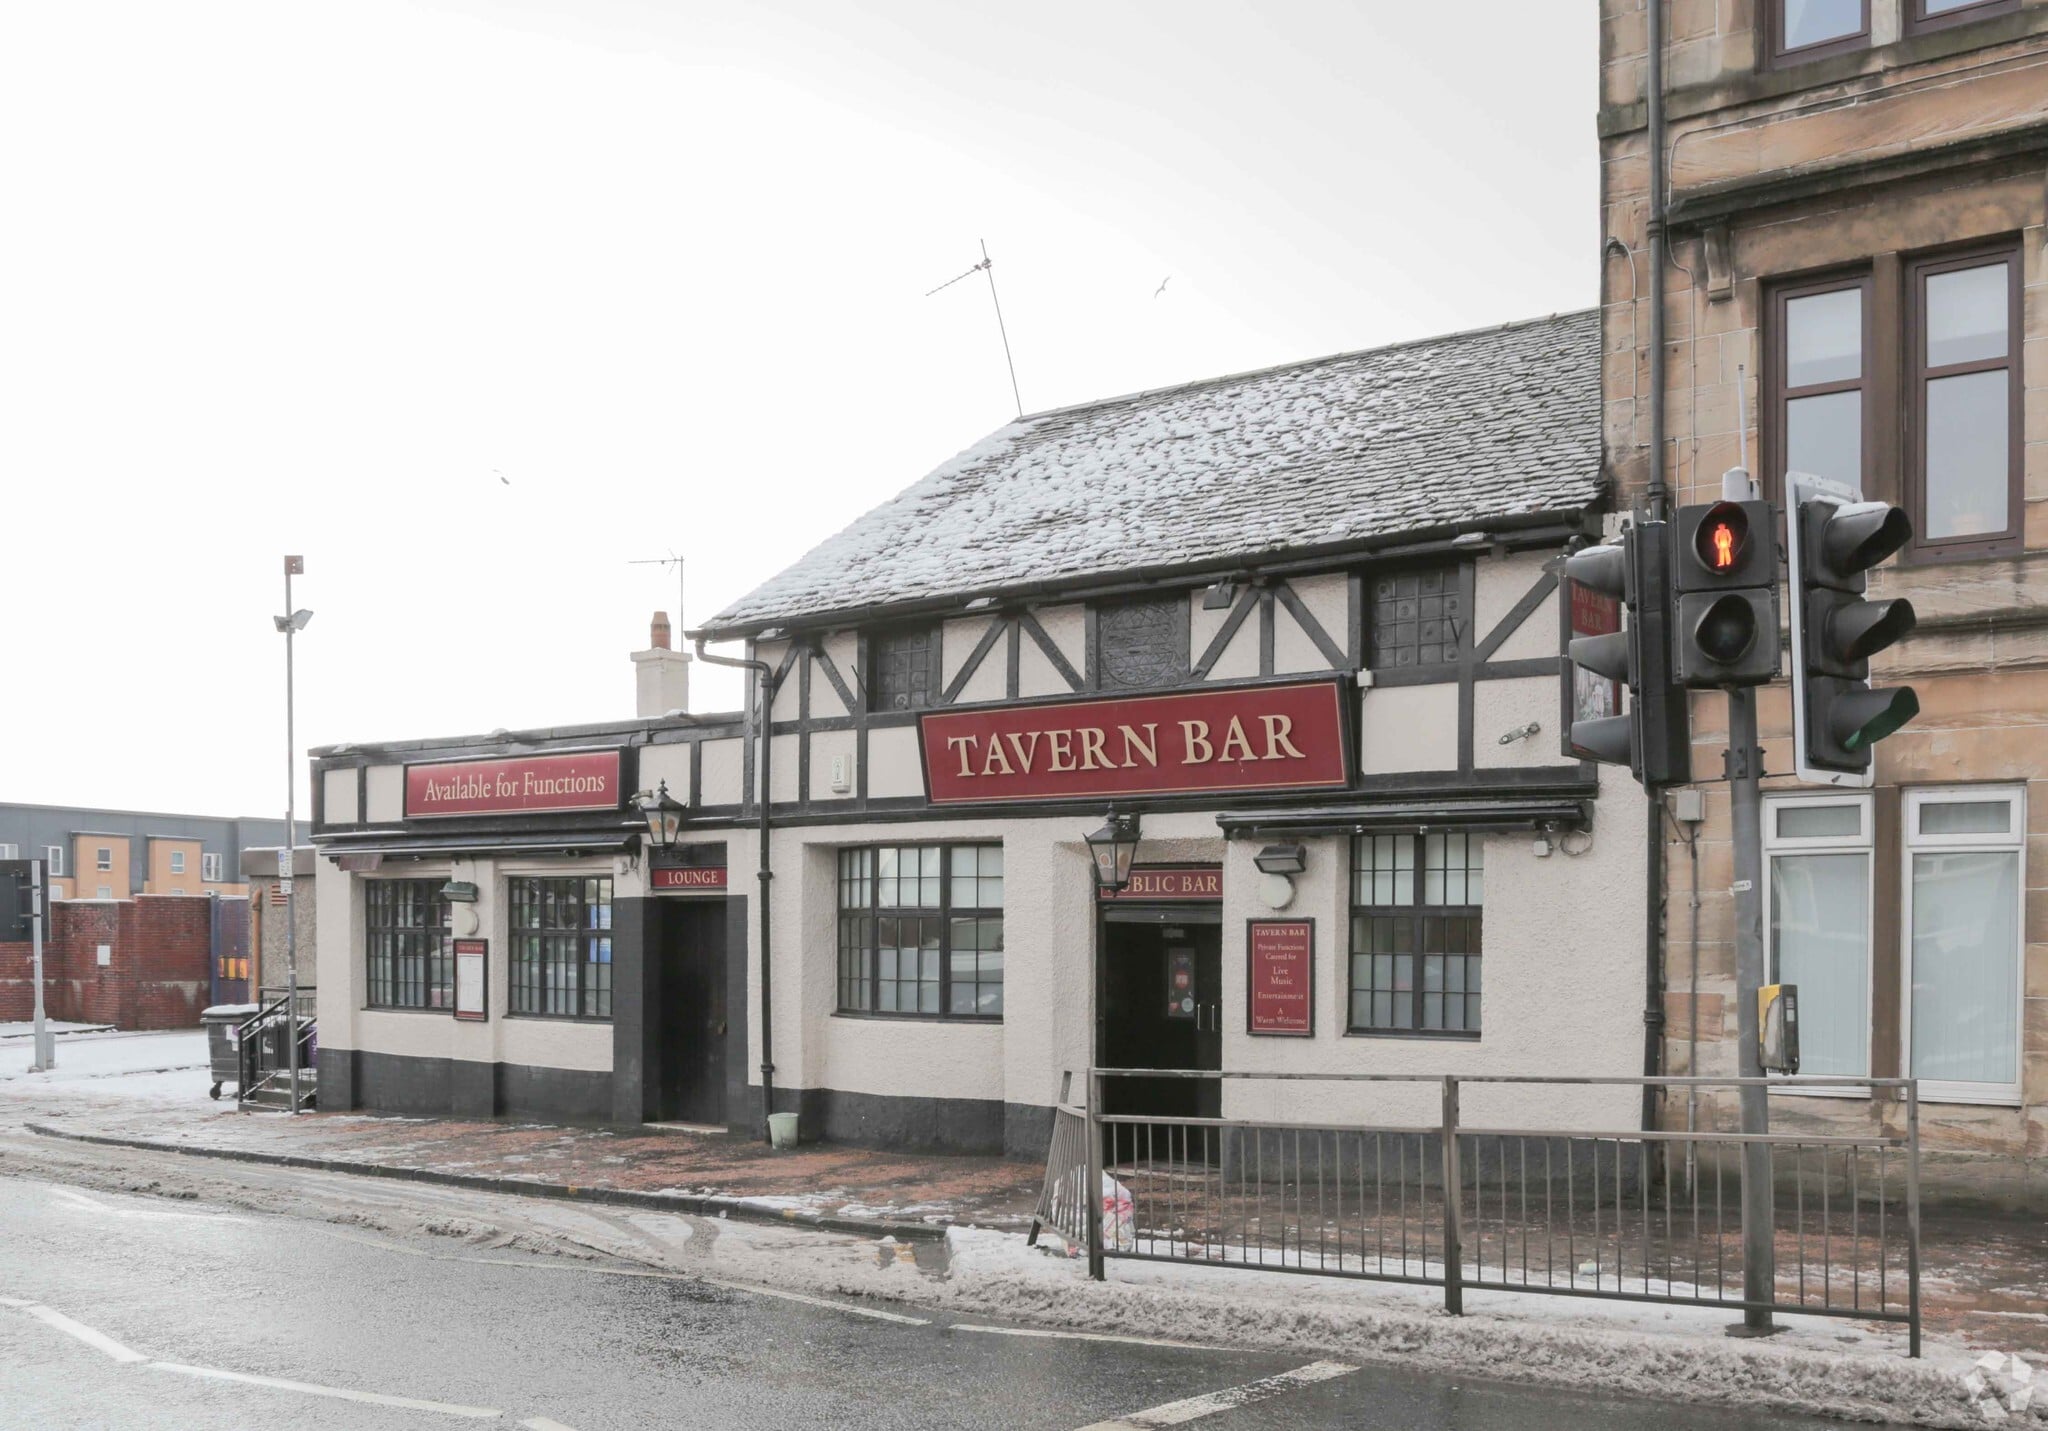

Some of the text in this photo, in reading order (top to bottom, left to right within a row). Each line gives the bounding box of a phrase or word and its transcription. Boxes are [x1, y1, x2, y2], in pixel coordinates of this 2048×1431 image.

[1582, 608, 1602, 631] BAR
[947, 714, 1307, 777] TAVERN BAR
[424, 769, 606, 802] Available for Functions
[668, 870, 718, 884] LOUNGE
[1107, 876, 1218, 892] UBLIC BAR
[1257, 944, 1277, 952] Private
[1273, 966, 1288, 975] Live
[1270, 976, 1293, 985] Music
[1257, 992, 1304, 1000] Entertainment
[1256, 1016, 1306, 1025] Warm Welcome
